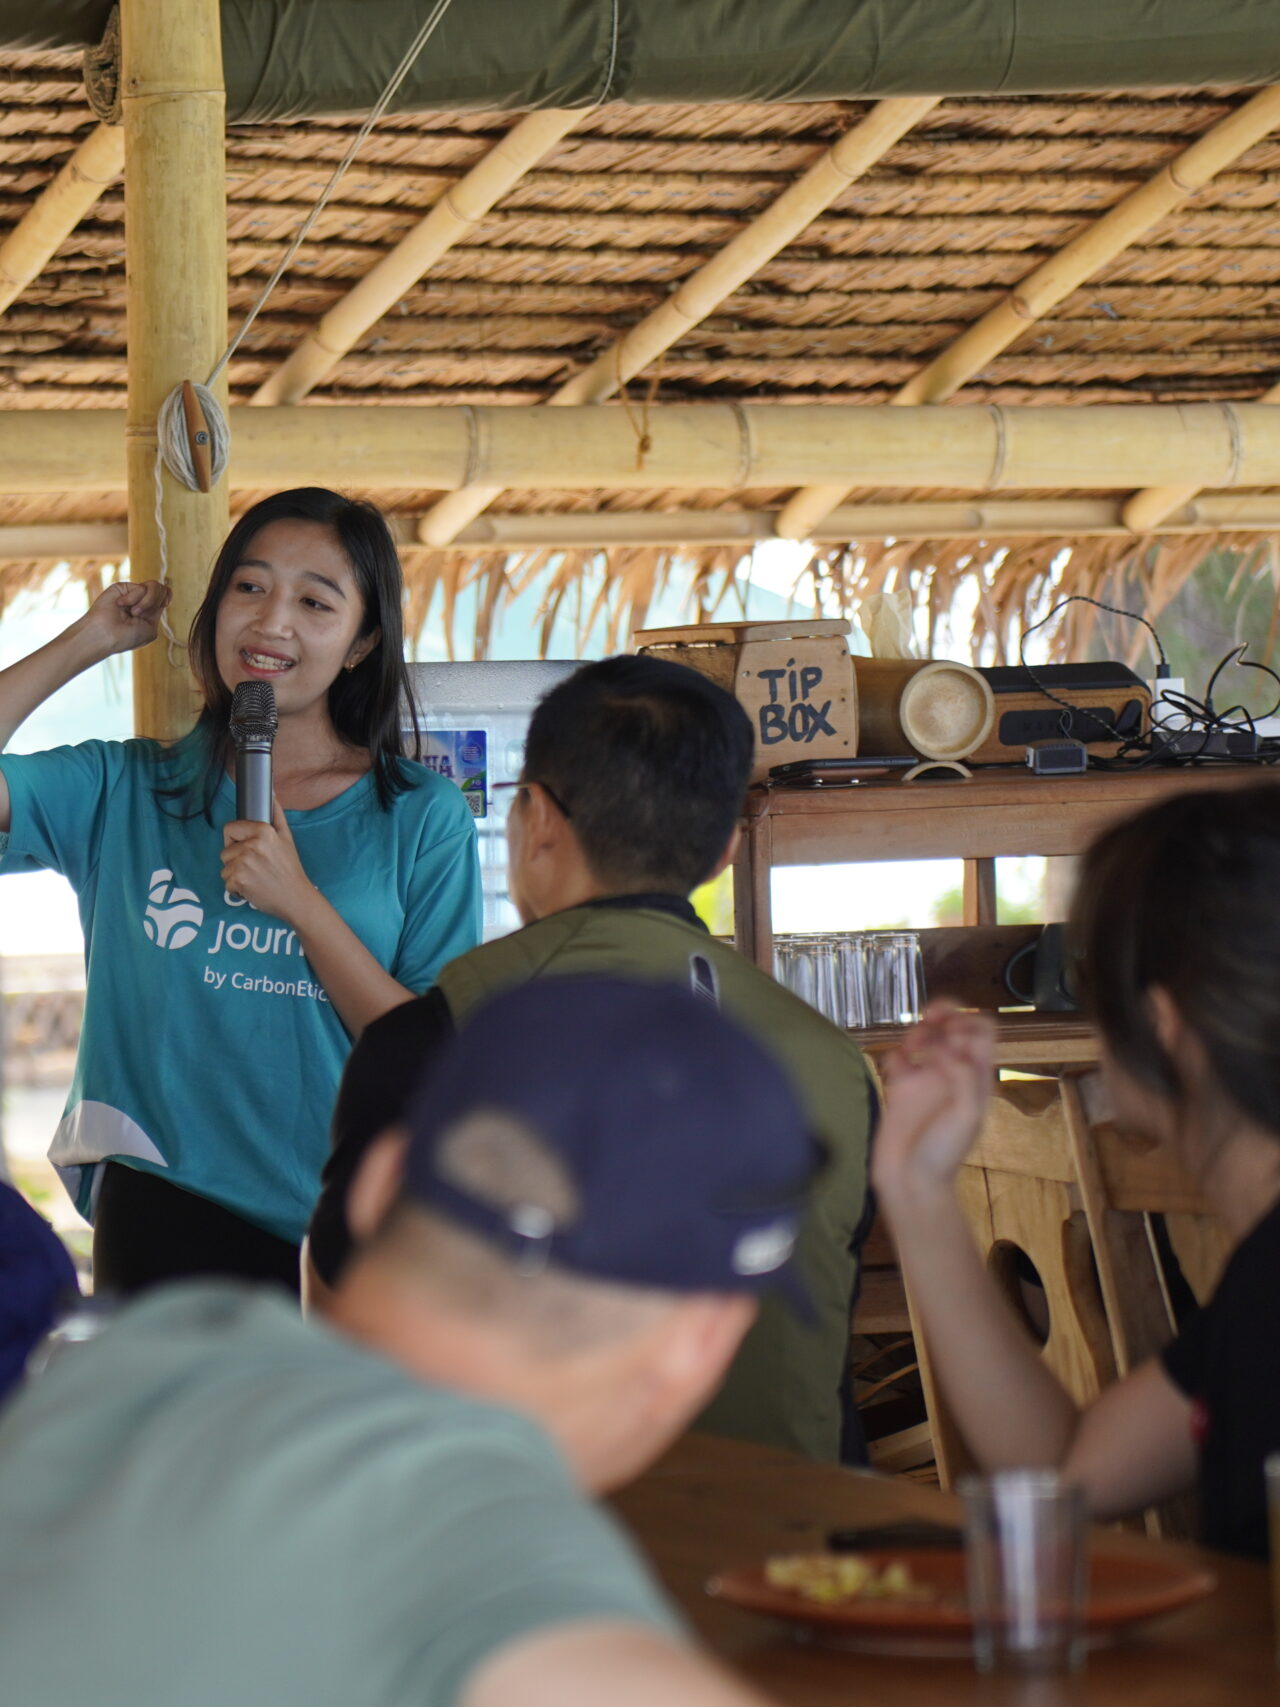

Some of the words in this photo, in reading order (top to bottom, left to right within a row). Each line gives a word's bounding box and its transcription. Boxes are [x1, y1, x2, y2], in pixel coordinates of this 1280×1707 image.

[759, 700, 837, 745] BOX
[204, 965, 228, 990] by
[231, 972, 330, 1002] CarbonEtic
